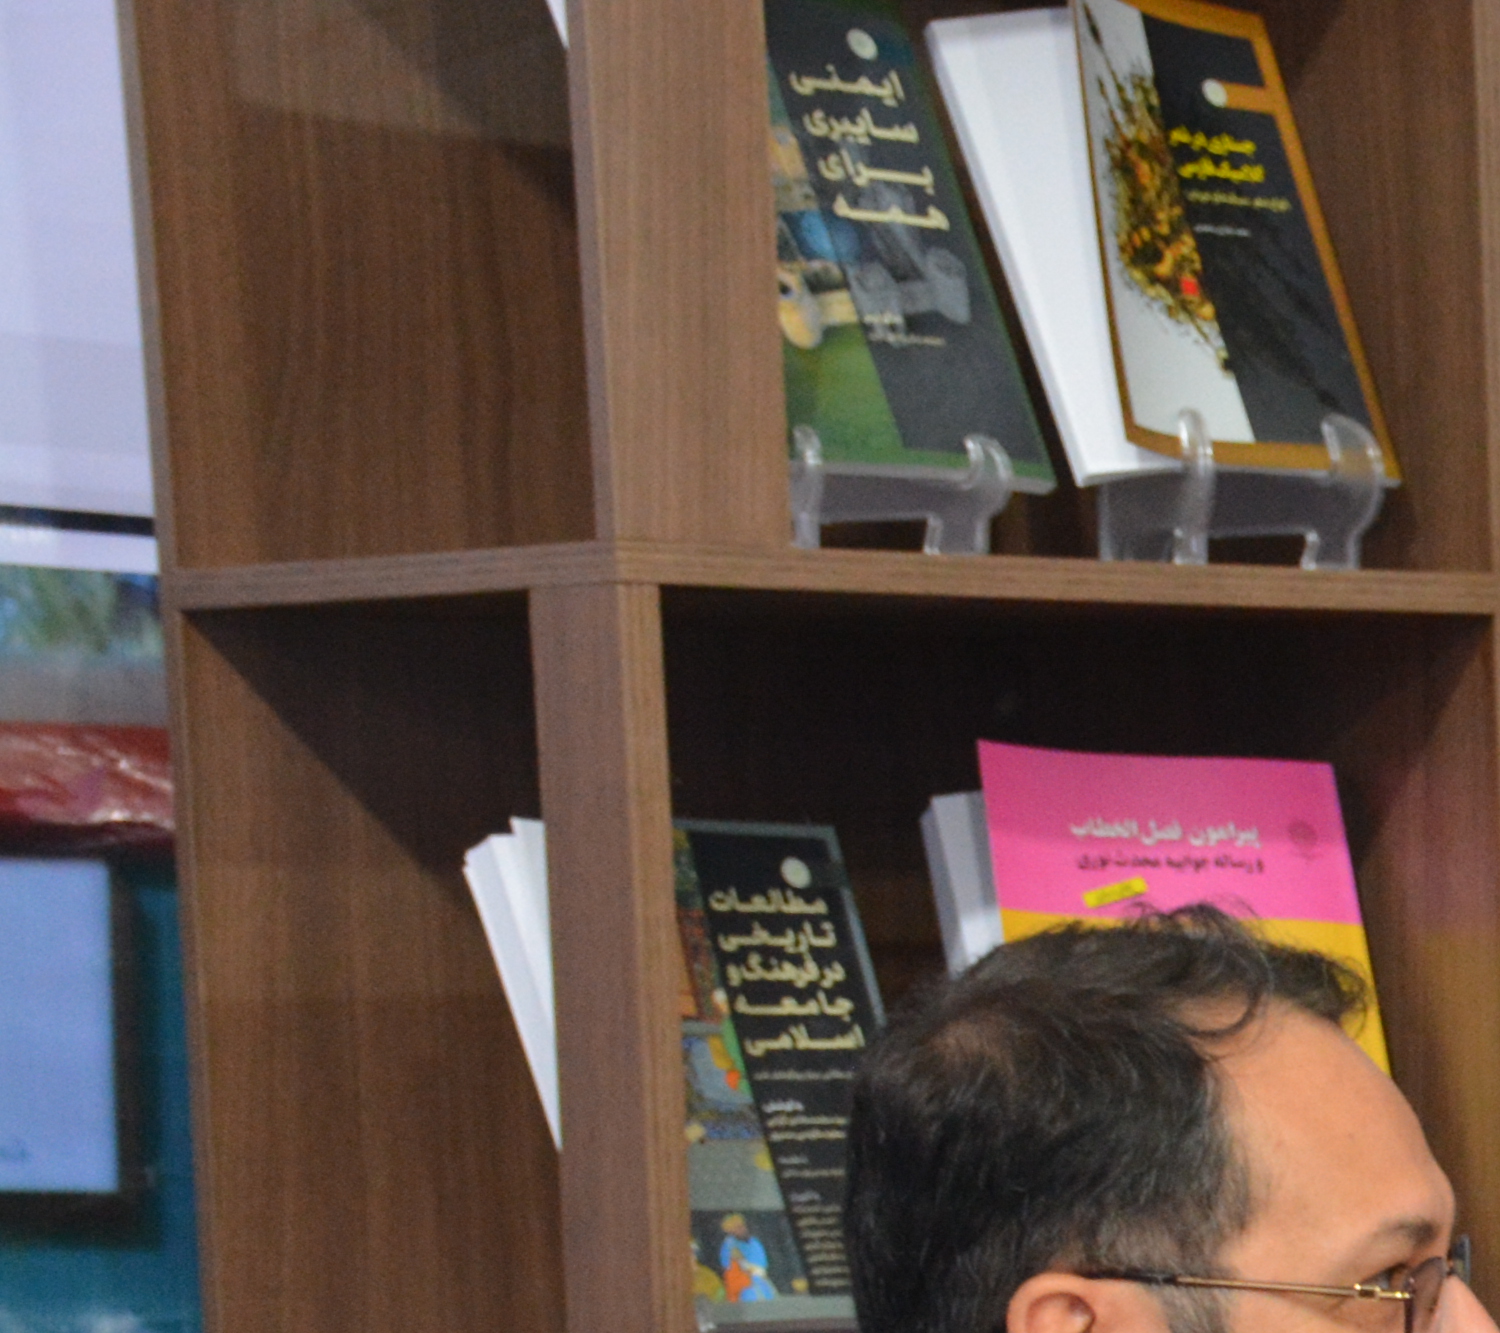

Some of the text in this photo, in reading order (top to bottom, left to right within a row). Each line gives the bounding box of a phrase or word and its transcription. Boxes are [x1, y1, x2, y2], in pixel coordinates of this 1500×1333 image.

[789, 64, 905, 107] ایمنی
[803, 107, 919, 145] سایبری
[817, 148, 934, 195] برای
[833, 192, 950, 231] همه
[709, 886, 828, 914] مطالعات
[718, 920, 836, 953] تاریخی
[726, 952, 846, 989] در فرهنگ و
[734, 990, 854, 1022] جامعه
[744, 1023, 866, 1057] اسلامی
